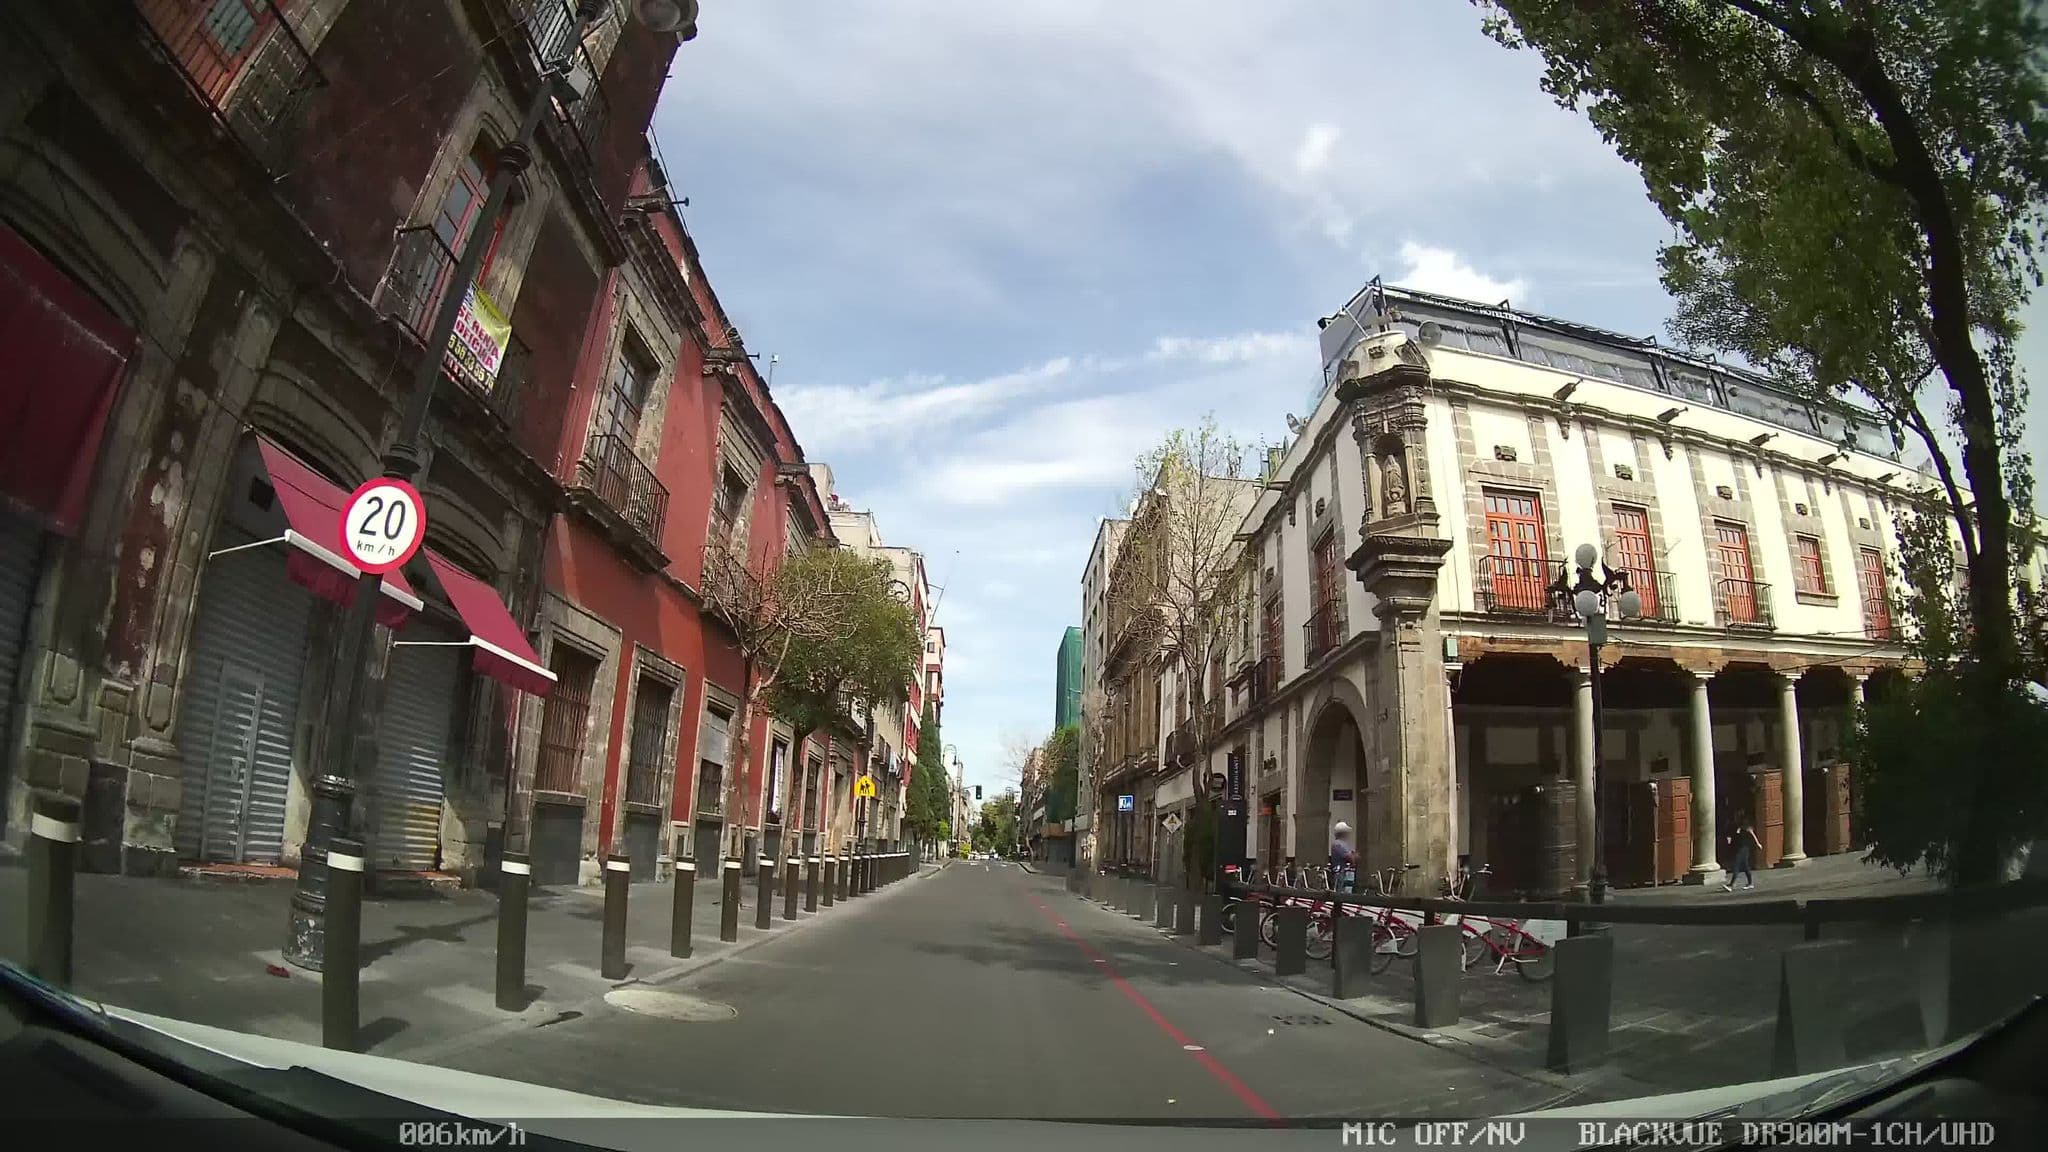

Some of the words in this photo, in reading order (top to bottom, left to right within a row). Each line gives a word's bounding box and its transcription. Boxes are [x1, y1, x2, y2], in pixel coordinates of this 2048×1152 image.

[456, 321, 494, 370] OFICINA
[458, 305, 472, 325] SE
[471, 319, 499, 360] RENTA
[360, 496, 406, 540] 20
